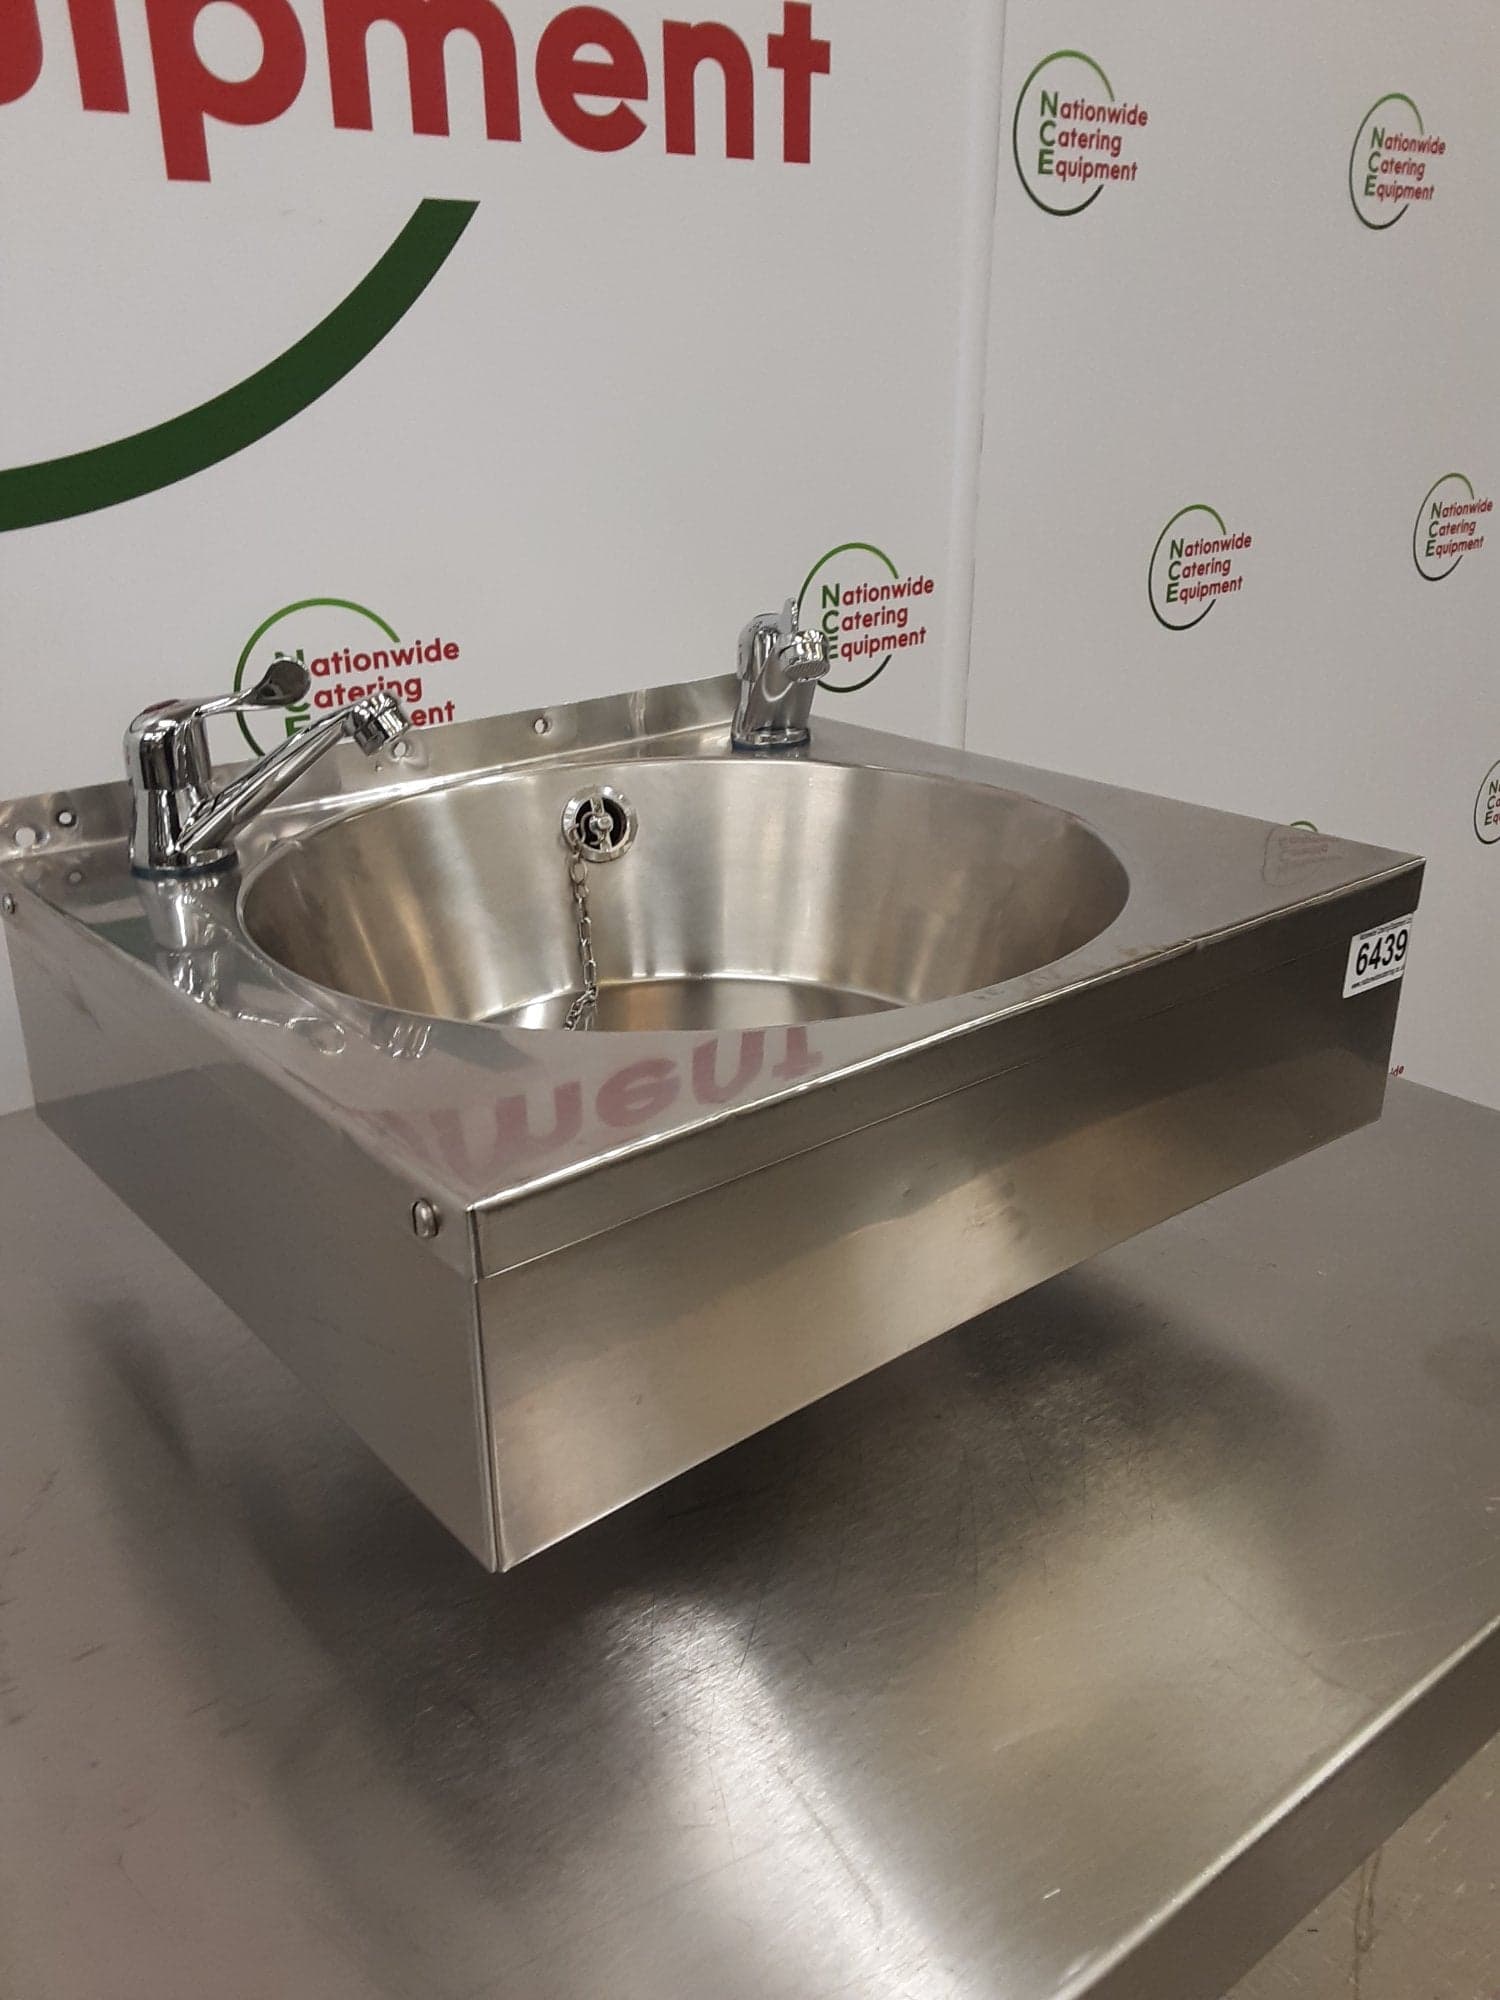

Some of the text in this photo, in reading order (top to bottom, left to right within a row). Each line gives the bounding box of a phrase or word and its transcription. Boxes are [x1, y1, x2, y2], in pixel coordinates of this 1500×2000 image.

[1040, 90, 1148, 126] Nationwide
[1039, 120, 1122, 157] Catering
[1371, 126, 1446, 155] Nationwide
[1038, 149, 1138, 184] Equipment
[1368, 151, 1426, 181] Catering
[1364, 174, 1434, 203] Equipment
[1431, 498, 1494, 519] Nationwide
[1428, 519, 1476, 538] Catering
[1169, 532, 1252, 560] Nationwide
[1425, 536, 1484, 559] Equipment
[1168, 557, 1231, 581] Catering
[821, 575, 934, 609] Nationwide
[1166, 576, 1243, 604] Equipment
[821, 606, 908, 634] Catering
[274, 638, 460, 677] ationwide
[284, 676, 422, 713] atering
[1356, 929, 1408, 976] 6439
